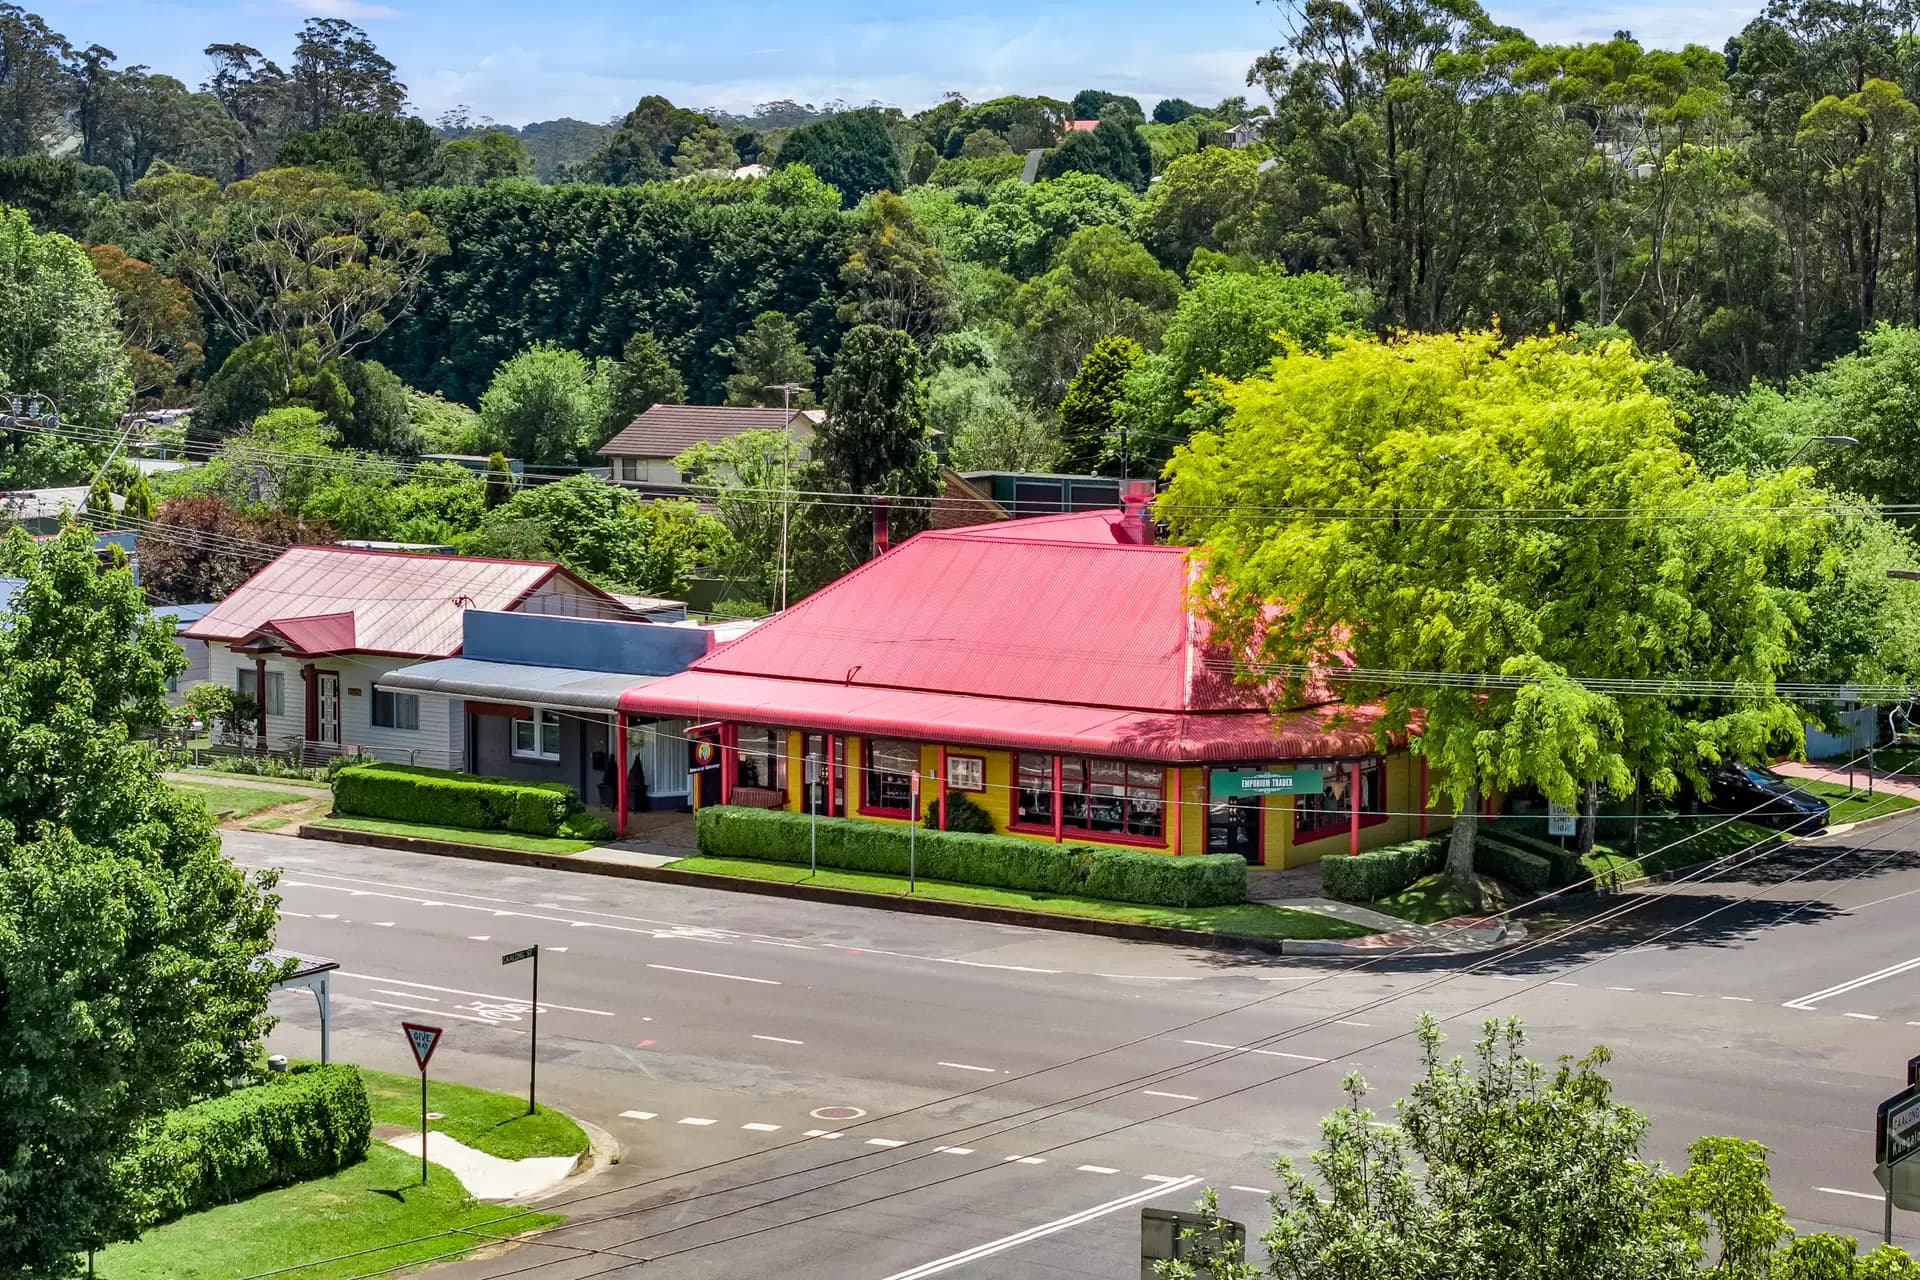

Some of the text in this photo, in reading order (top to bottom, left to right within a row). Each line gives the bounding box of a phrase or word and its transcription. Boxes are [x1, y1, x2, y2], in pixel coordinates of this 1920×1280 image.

[1242, 778, 1293, 788] EMPORIUM TRADER
[413, 1031, 432, 1042] GIVE
[416, 1041, 428, 1050] WAY
